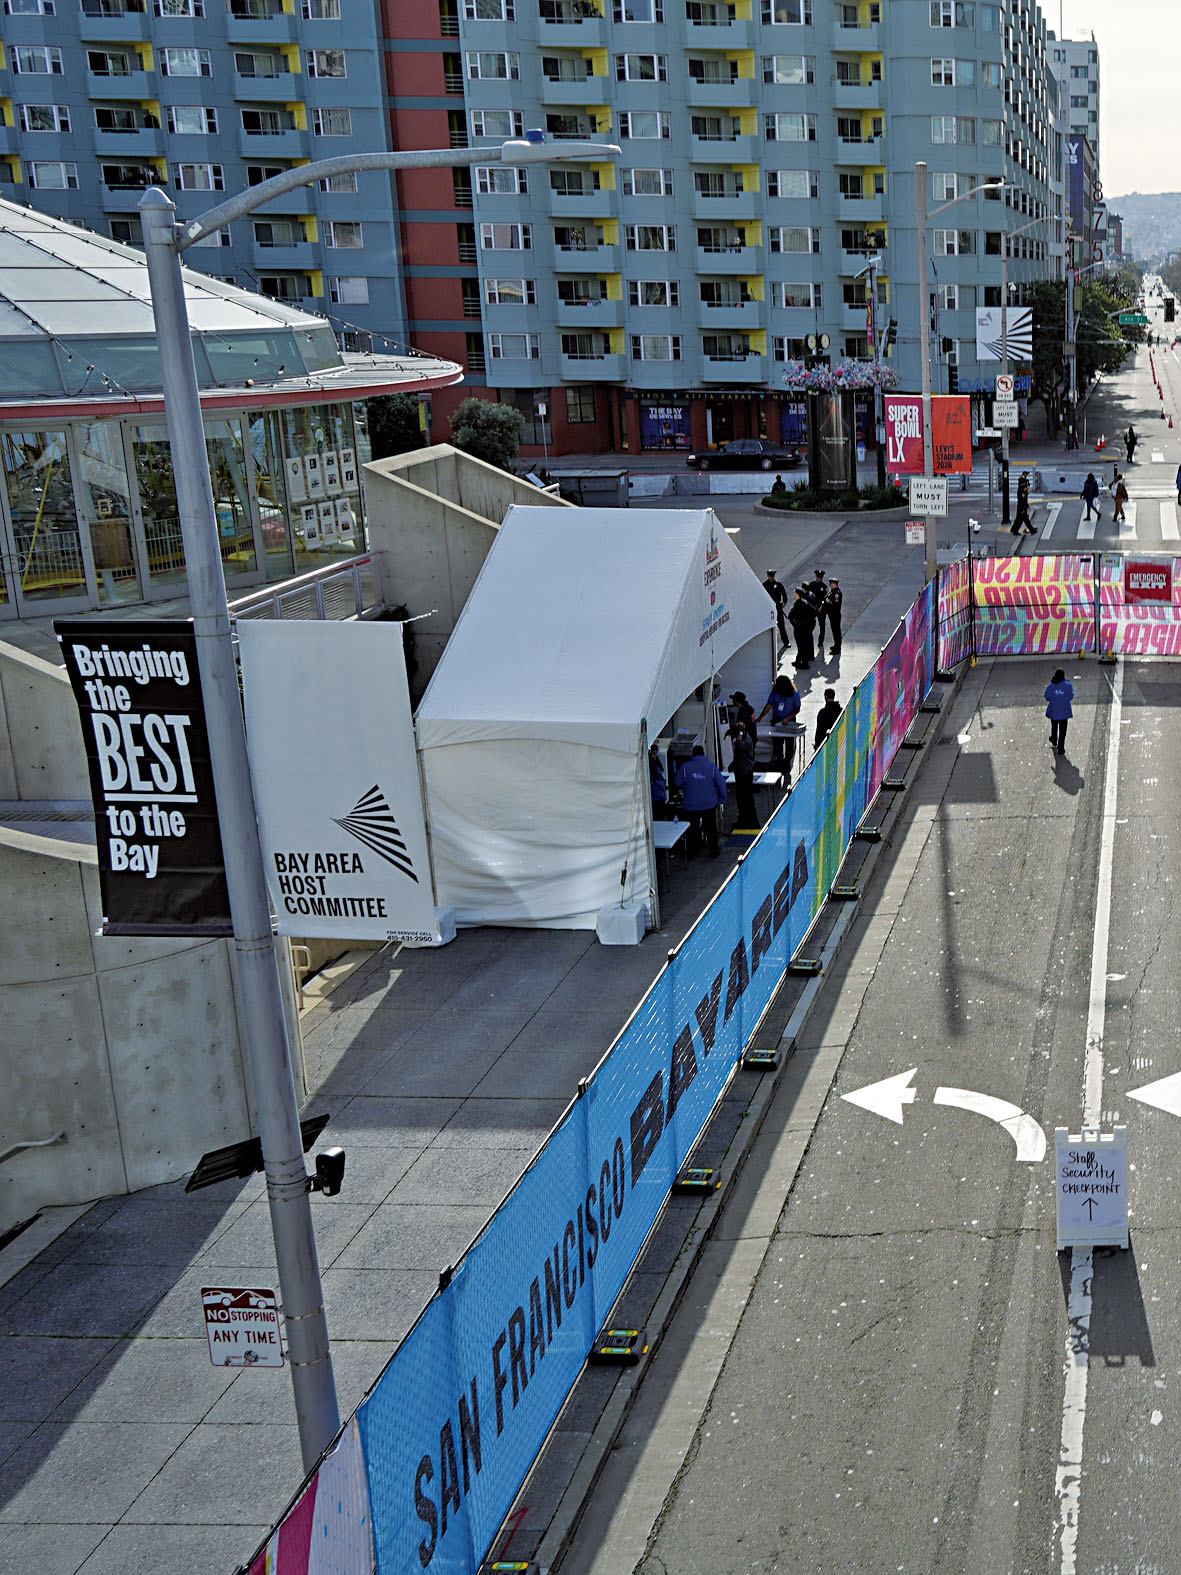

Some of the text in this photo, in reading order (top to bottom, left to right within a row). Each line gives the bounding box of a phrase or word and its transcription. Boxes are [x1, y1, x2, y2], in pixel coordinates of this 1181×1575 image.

[888, 405, 919, 422] SUPER
[895, 421, 922, 438] BOWL
[888, 437, 906, 463] LX
[936, 445, 956, 453] LEVI'S
[936, 462, 953, 470] 2026
[916, 493, 941, 501] MUST
[1130, 573, 1167, 583] EMERGENCY
[72, 644, 190, 686] Bringing
[84, 678, 132, 711] the
[91, 712, 197, 793] BEST
[106, 803, 187, 837] to the
[108, 837, 160, 879] Bay
[274, 852, 364, 874] BAY AREA
[278, 875, 327, 896] HOST
[284, 896, 388, 918] COMMITTEE
[1068, 1151, 1099, 1170] Staff
[1061, 1164, 1115, 1184] Security
[1062, 1183, 1121, 1194] CHECKPOINT
[414, 836, 809, 1570] SAN FRANCISCO BAY AREA
[206, 1309, 276, 1323] NO STOPPING
[213, 1330, 277, 1344] ANY TIME
